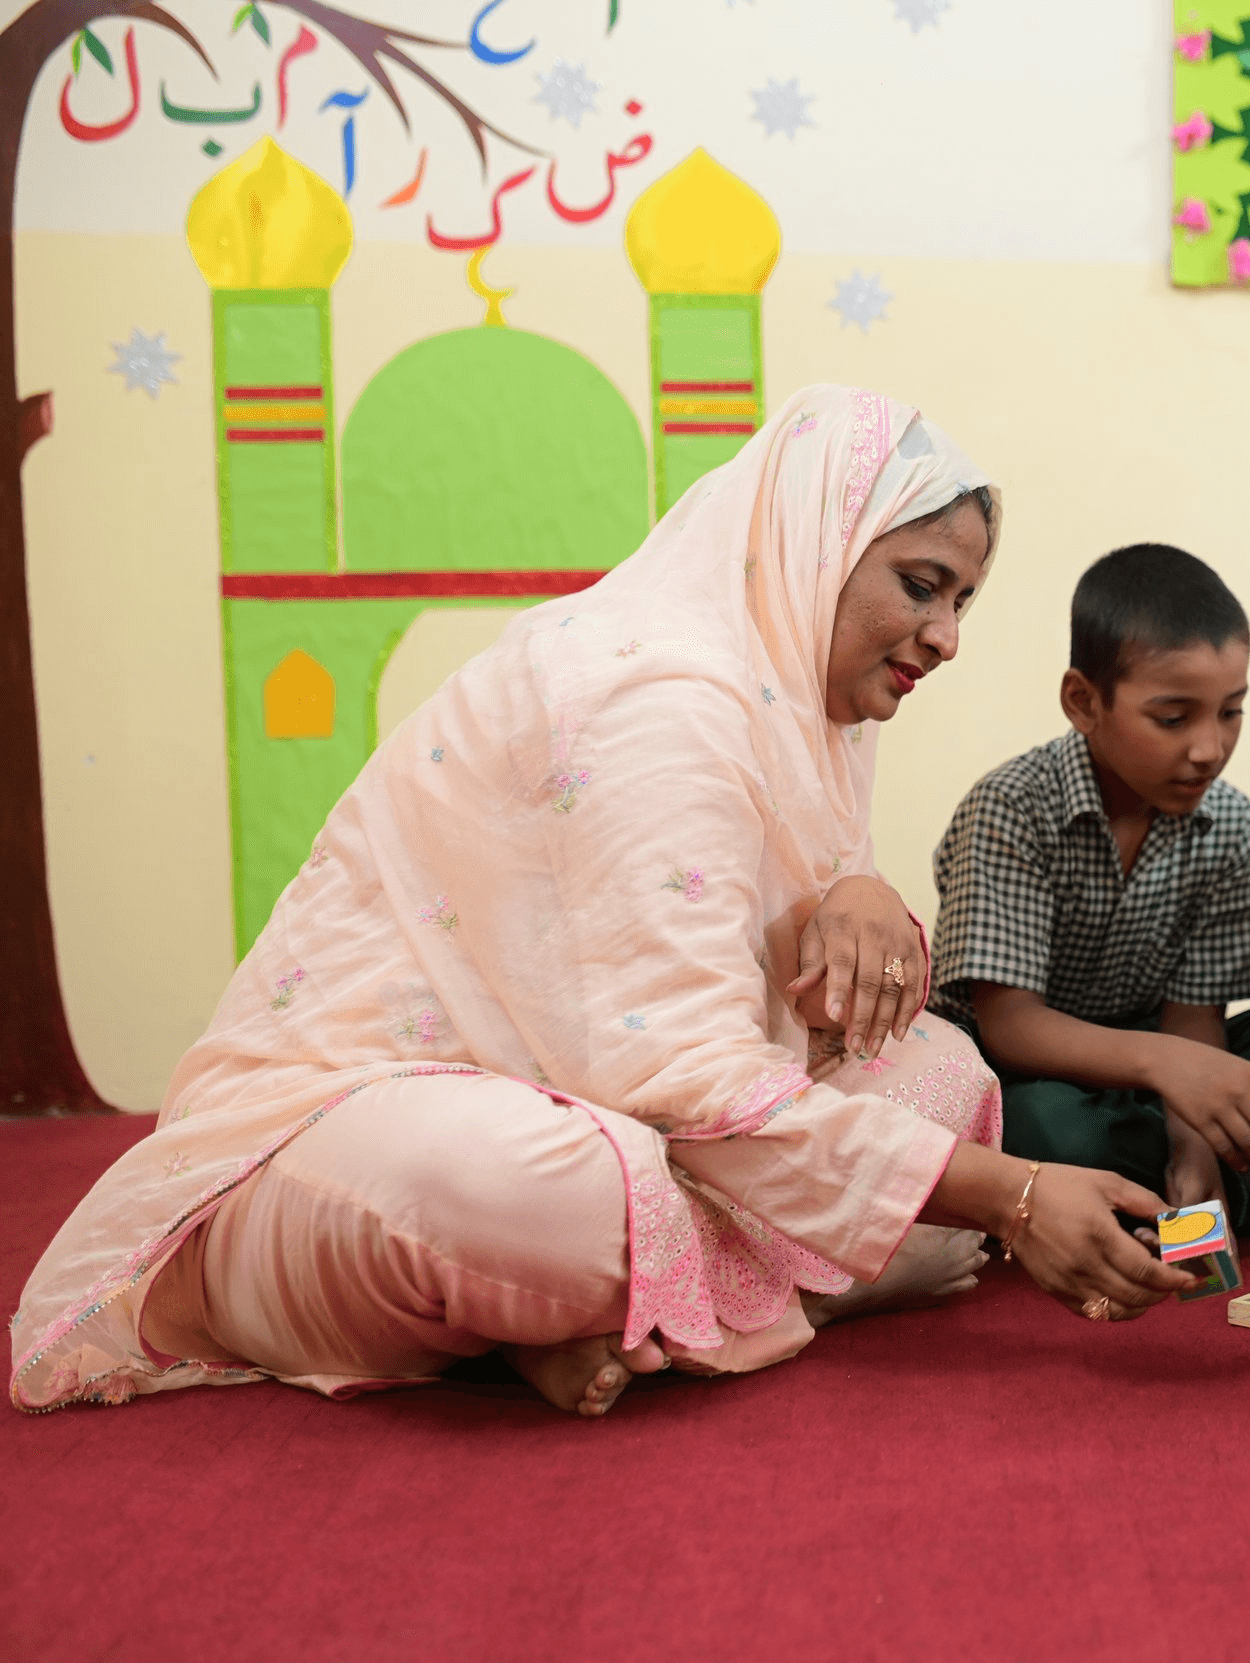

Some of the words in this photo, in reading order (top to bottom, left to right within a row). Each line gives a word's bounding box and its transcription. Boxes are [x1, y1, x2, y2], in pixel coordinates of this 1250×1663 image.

[59, 25, 141, 142] ل
[160, 80, 262, 157] ب
[320, 86, 370, 198] آ
[380, 146, 428, 210] ر
[546, 98, 653, 225] ض
